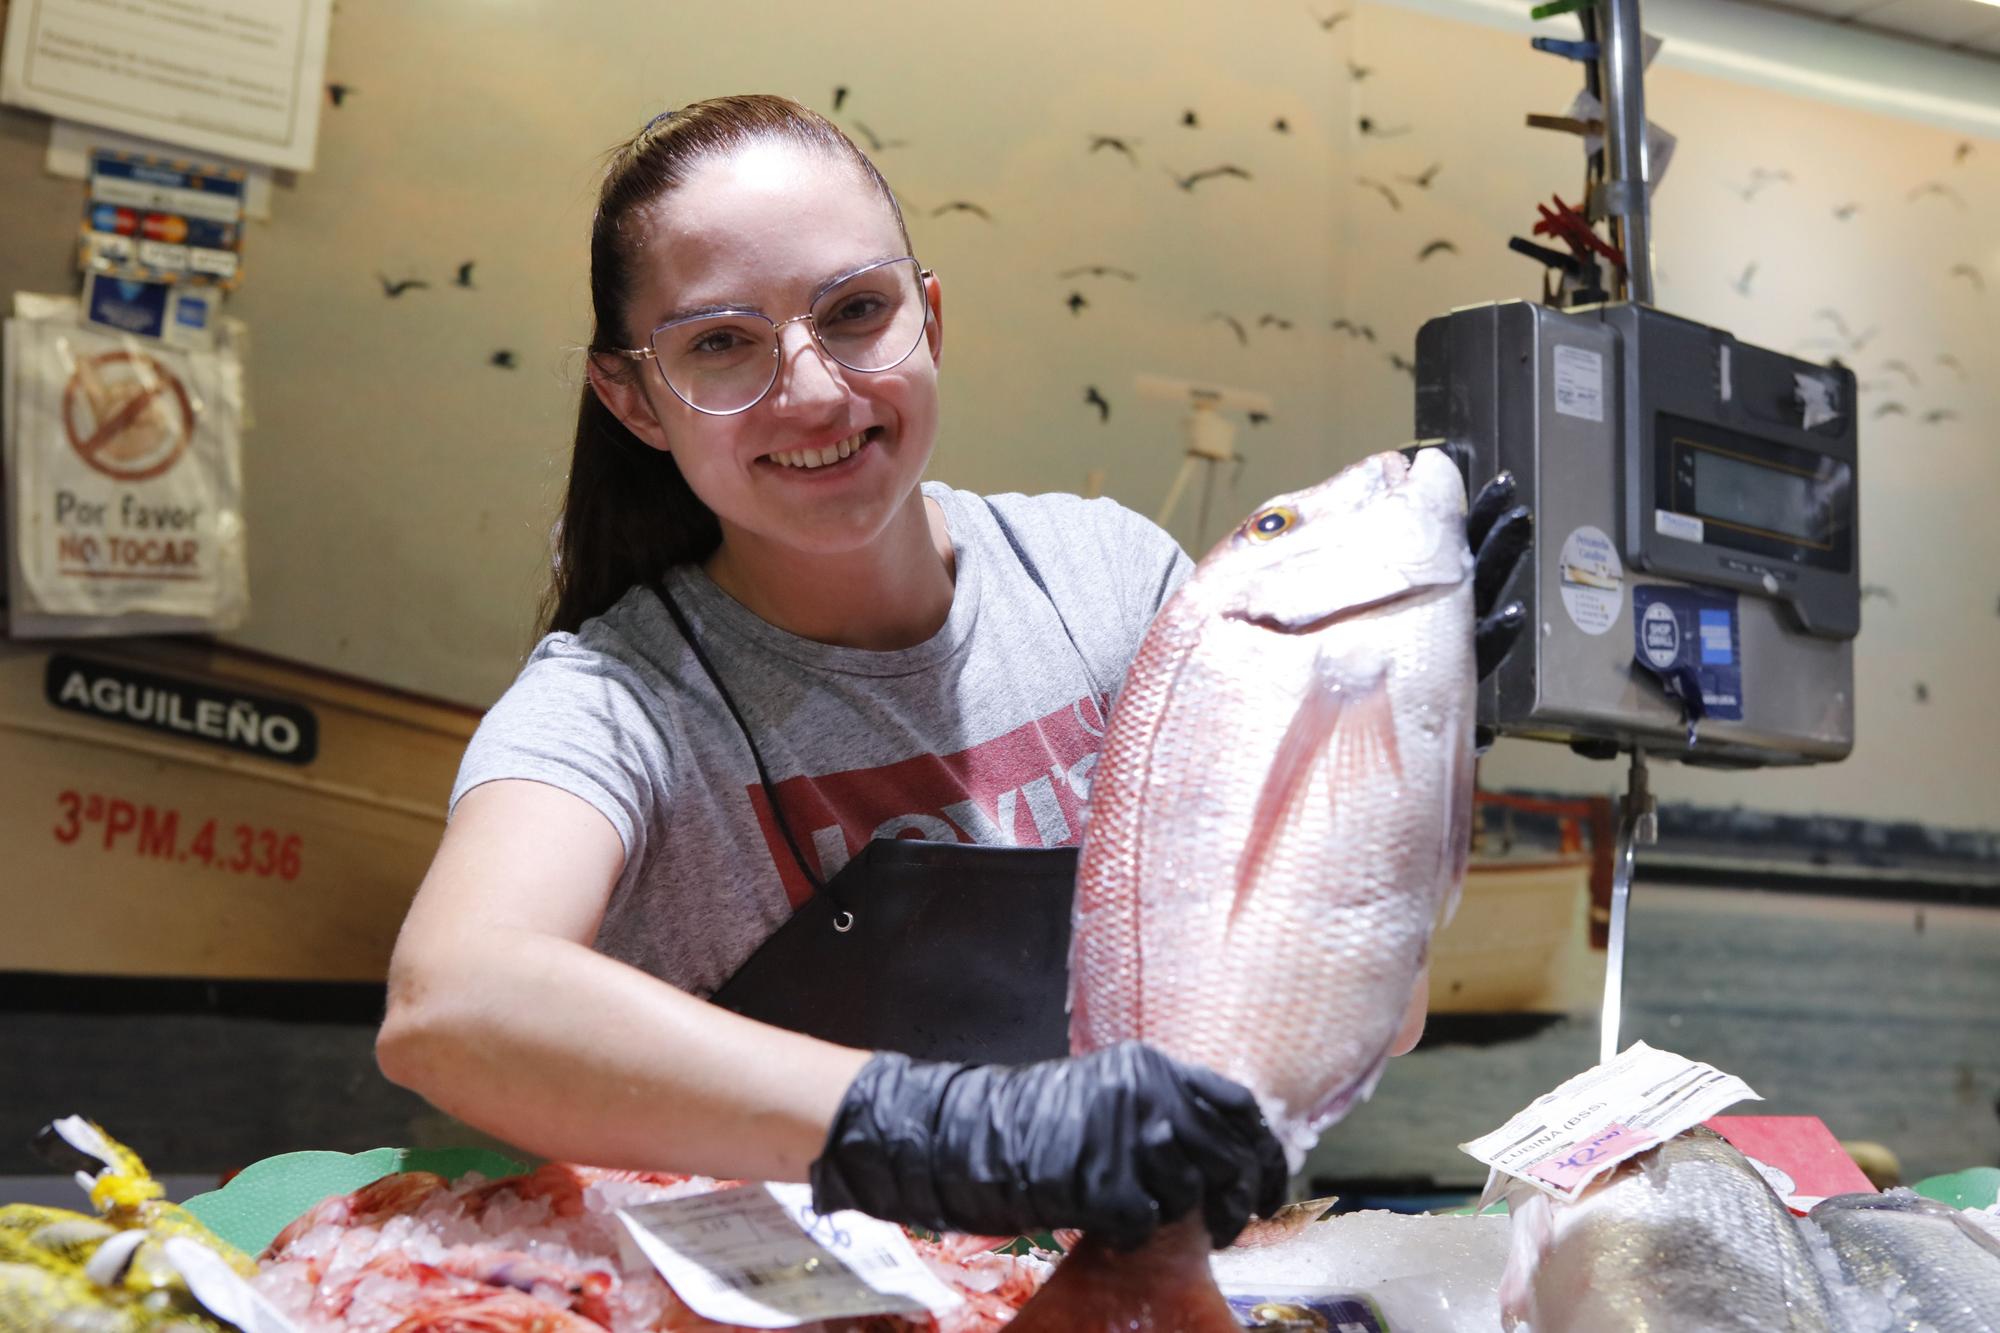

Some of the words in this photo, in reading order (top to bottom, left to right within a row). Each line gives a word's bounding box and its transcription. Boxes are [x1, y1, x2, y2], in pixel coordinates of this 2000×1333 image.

[56, 490, 105, 523] Por
[121, 494, 200, 529] favor
[58, 534, 97, 563] NO
[108, 536, 199, 567] TOCAR
[60, 671, 301, 754] AGUILEÑO
[1501, 1129, 1562, 1165] LUBINA
